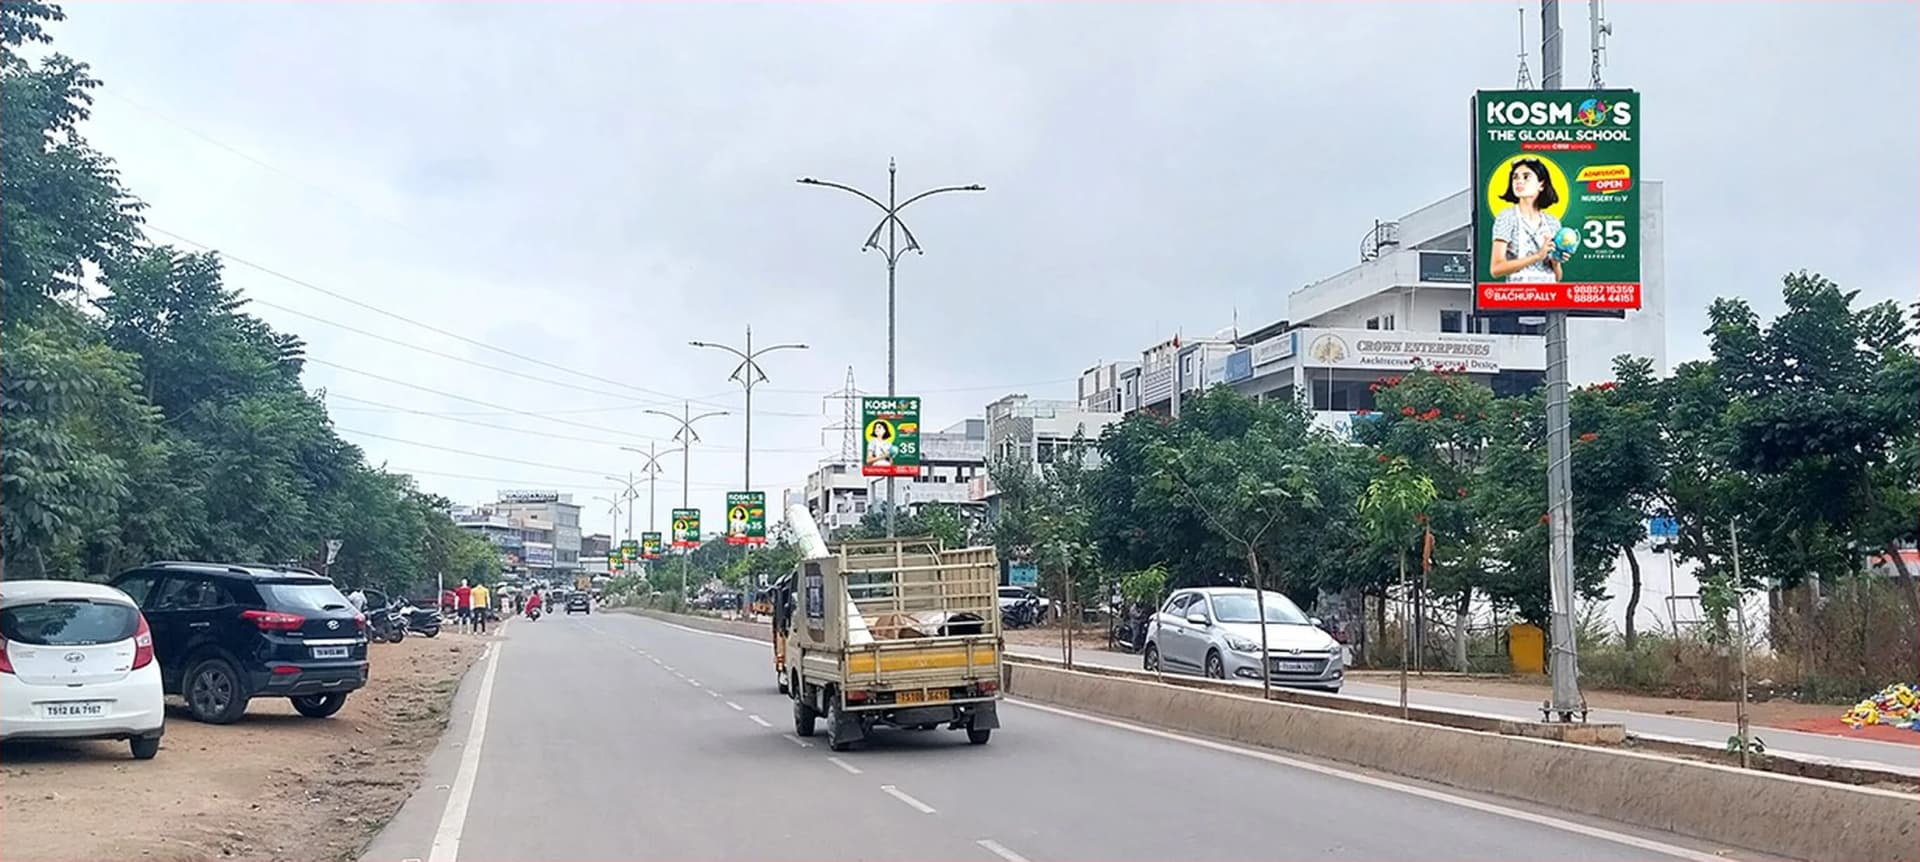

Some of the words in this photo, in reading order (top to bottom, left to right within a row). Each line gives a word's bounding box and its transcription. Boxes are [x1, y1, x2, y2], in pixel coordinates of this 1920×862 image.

[1488, 130, 1516, 141] THE
[1518, 130, 1573, 141] GLOBAL
[1576, 130, 1631, 141] SCHOOL
[1596, 180, 1623, 189] OPEN
[1583, 220, 1626, 249] 35
[1494, 291, 1557, 302] BACHUPALLY
[1357, 340, 1402, 353] CROWN
[1404, 341, 1490, 356] ENTERPRISES
[1471, 360, 1498, 370] Design
[900, 442, 916, 454] 35
[48, 707, 67, 715] TS12
[70, 707, 80, 715] EA
